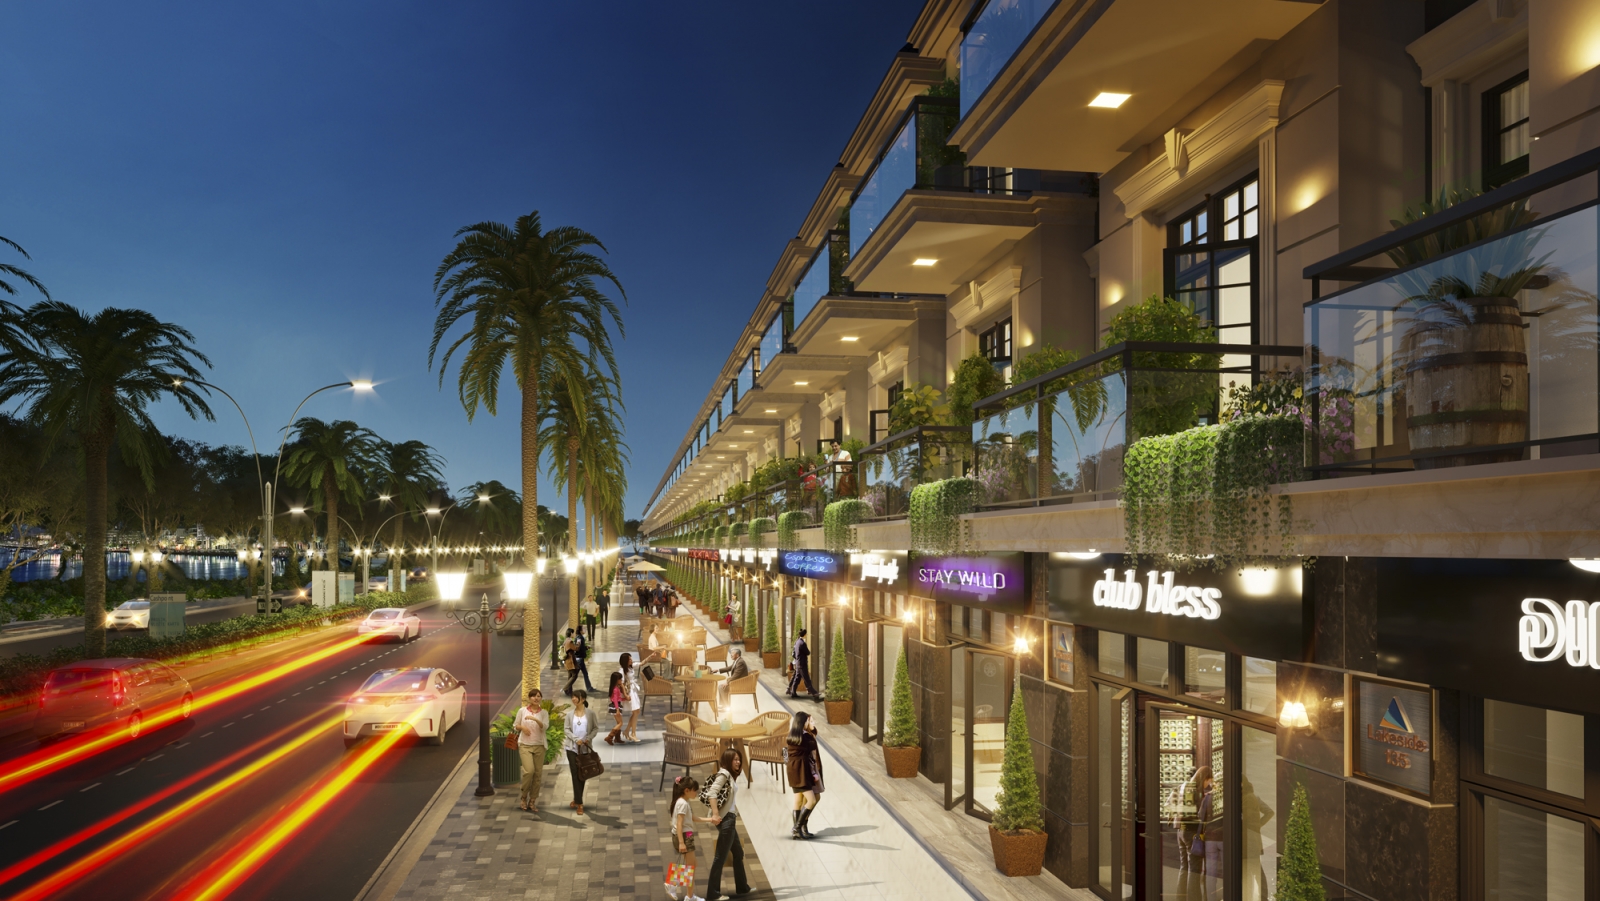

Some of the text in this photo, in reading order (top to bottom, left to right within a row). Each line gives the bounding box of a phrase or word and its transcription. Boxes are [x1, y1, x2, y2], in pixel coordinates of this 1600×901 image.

[784, 552, 834, 564] Espresso
[786, 562, 829, 572] Coffee
[918, 568, 954, 584] STAY
[957, 570, 1006, 590] WILD
[150, 594, 174, 603] Cashpont
[1093, 568, 1222, 620] club bless
[1367, 723, 1430, 752] Lakeside
[1384, 748, 1411, 769] 135
